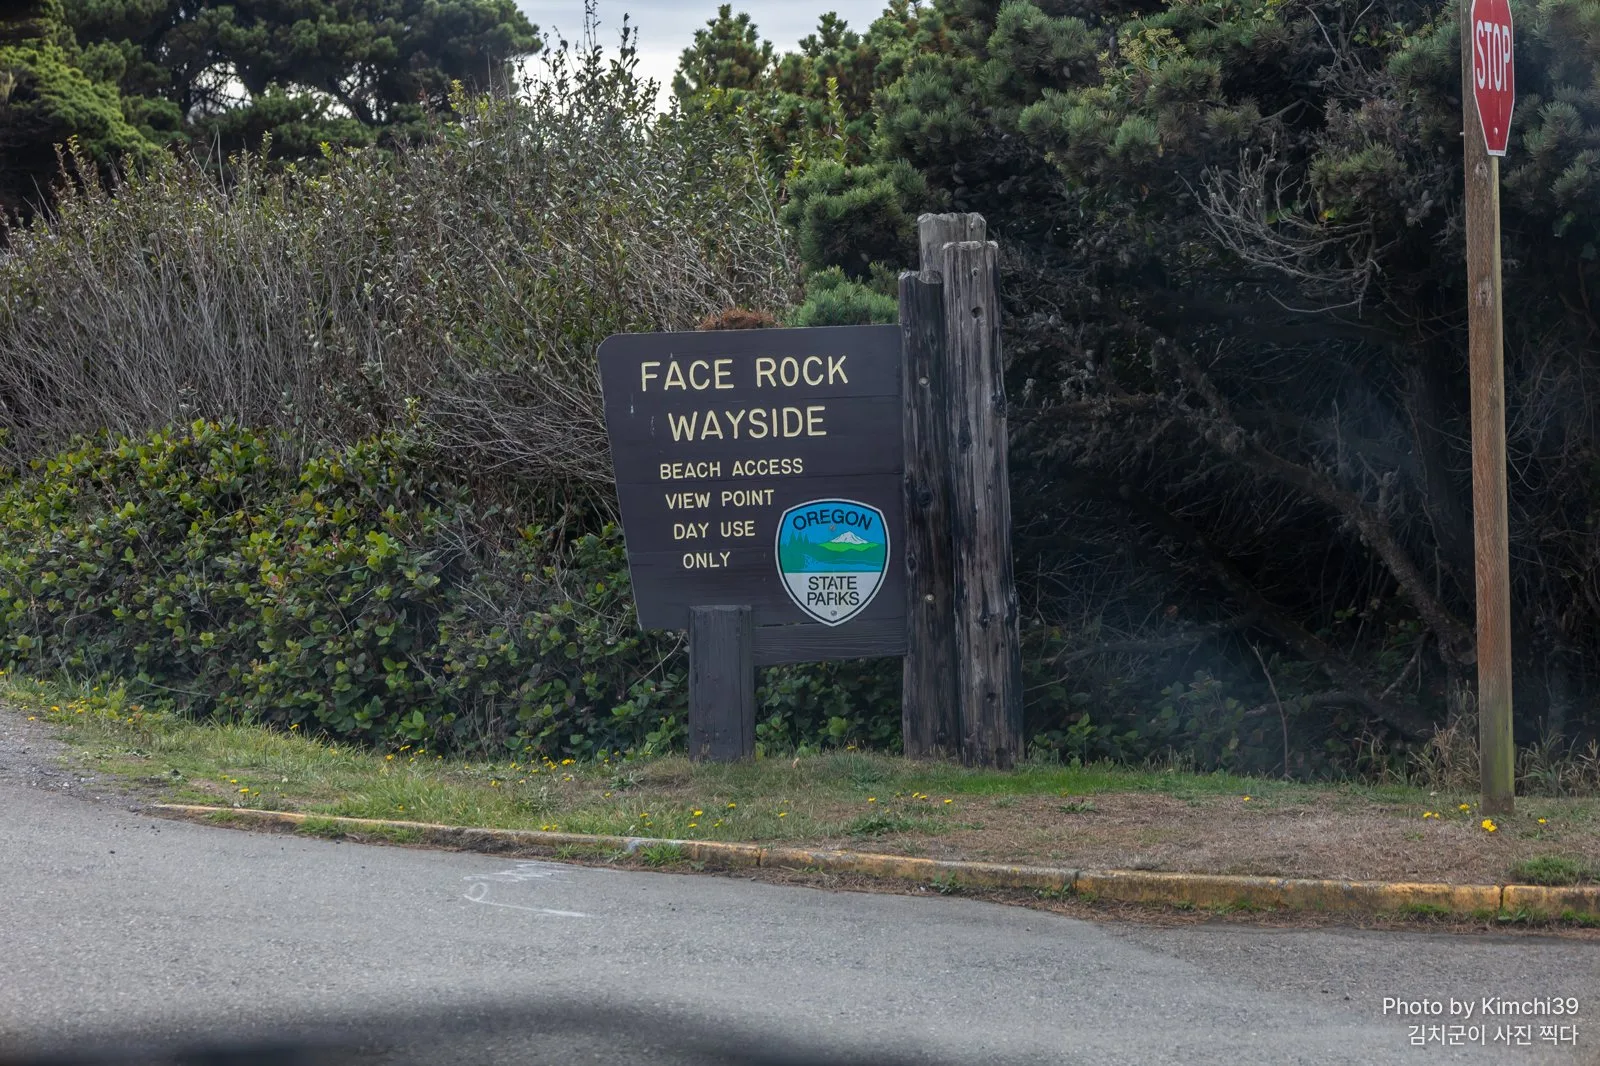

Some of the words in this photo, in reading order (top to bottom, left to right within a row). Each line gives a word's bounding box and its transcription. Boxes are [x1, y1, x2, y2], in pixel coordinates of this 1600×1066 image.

[1476, 19, 1511, 92] STOP
[640, 358, 735, 392] FACE
[755, 355, 849, 388] ROCK
[668, 405, 827, 442] WAYSIDE
[660, 461, 721, 480] BEACH
[731, 458, 804, 477] ACCESS
[665, 492, 711, 510] VIEW
[721, 489, 775, 507] POINT
[673, 522, 709, 540] DAY
[720, 521, 756, 538] USE
[792, 509, 873, 531] OREGON
[682, 551, 731, 569] ONLY
[808, 576, 858, 591] STATE
[806, 591, 860, 607] PARKS
